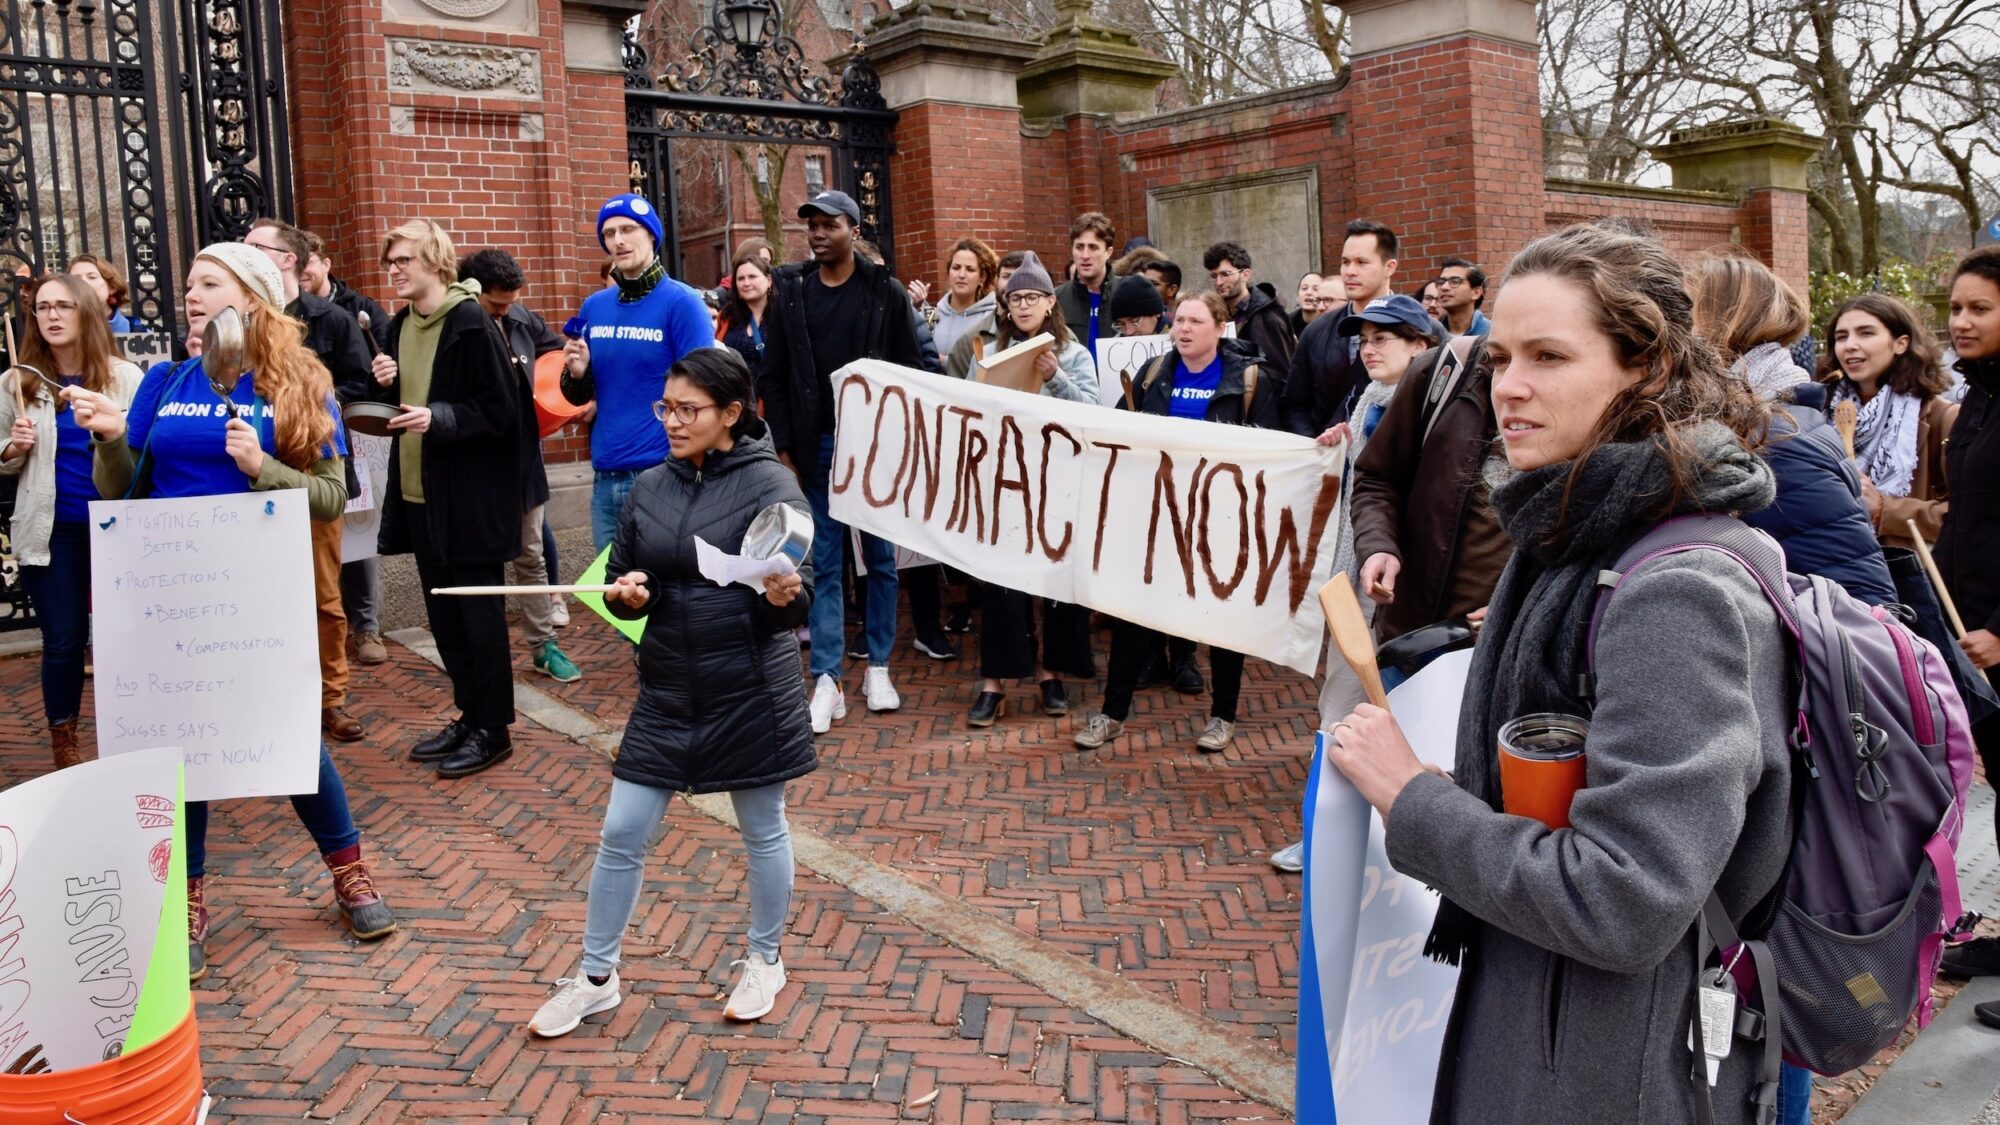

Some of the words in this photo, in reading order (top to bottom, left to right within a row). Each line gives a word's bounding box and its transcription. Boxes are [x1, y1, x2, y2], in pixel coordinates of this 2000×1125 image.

[590, 325, 615, 339] UNION
[616, 325, 663, 342] STRONG
[158, 401, 211, 417] UNION
[831, 373, 1131, 575] CONTRACT
[1143, 450, 1340, 616] NOW
[124, 505, 200, 531] FIGHTING
[212, 505, 241, 525] FOR
[142, 536, 199, 558] BETTER
[114, 674, 139, 693] AND
[148, 672, 234, 694] RESPECT!
[183, 752, 213, 768] ACT
